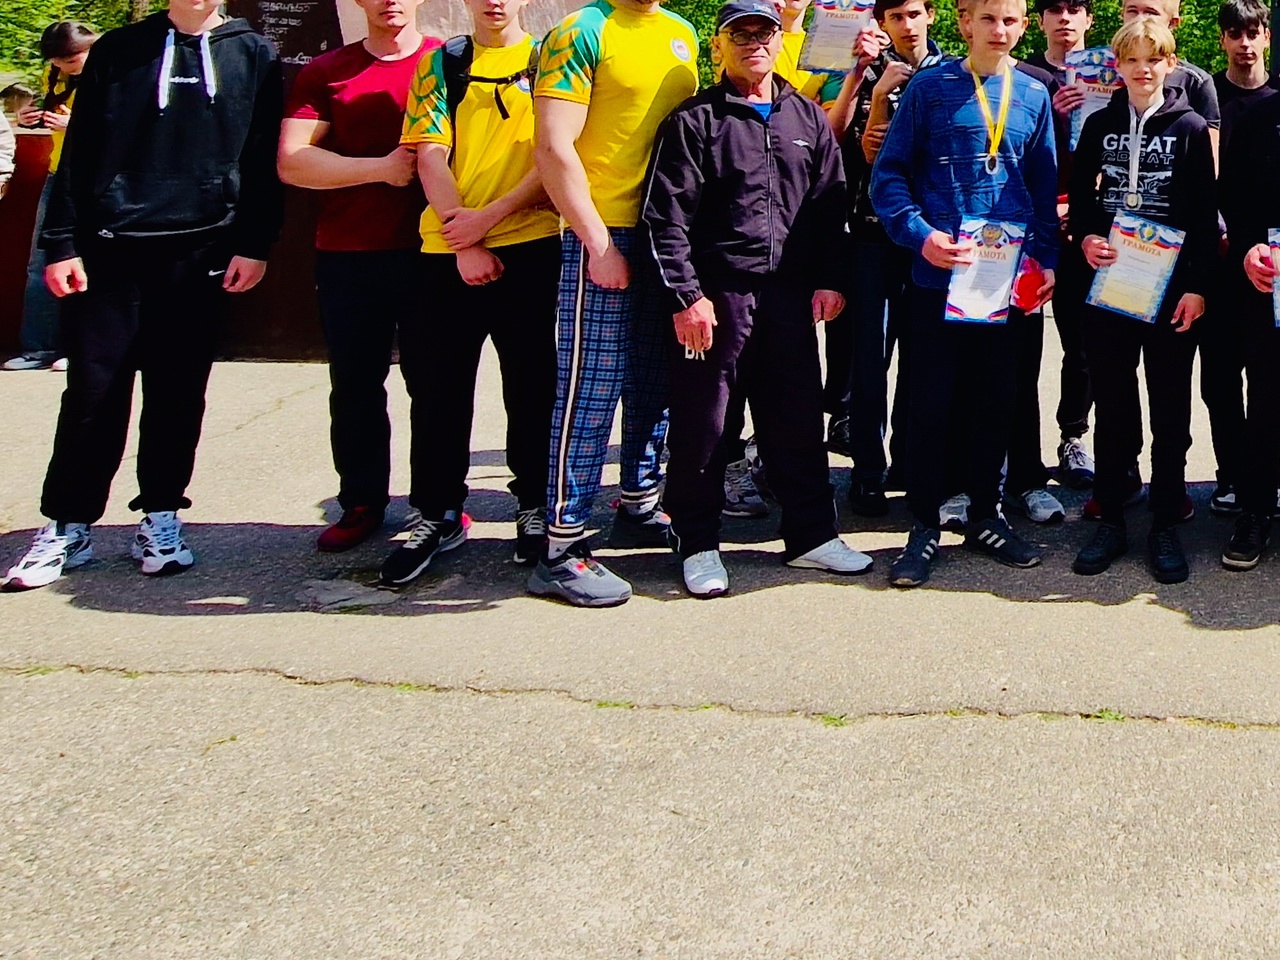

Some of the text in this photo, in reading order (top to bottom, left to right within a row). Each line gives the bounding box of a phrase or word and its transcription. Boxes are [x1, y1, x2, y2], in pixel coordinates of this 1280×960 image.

[825, 12, 860, 20] ГРАМОТА
[1102, 133, 1177, 153] GREAT
[1122, 238, 1162, 257] ГРАМОТА
